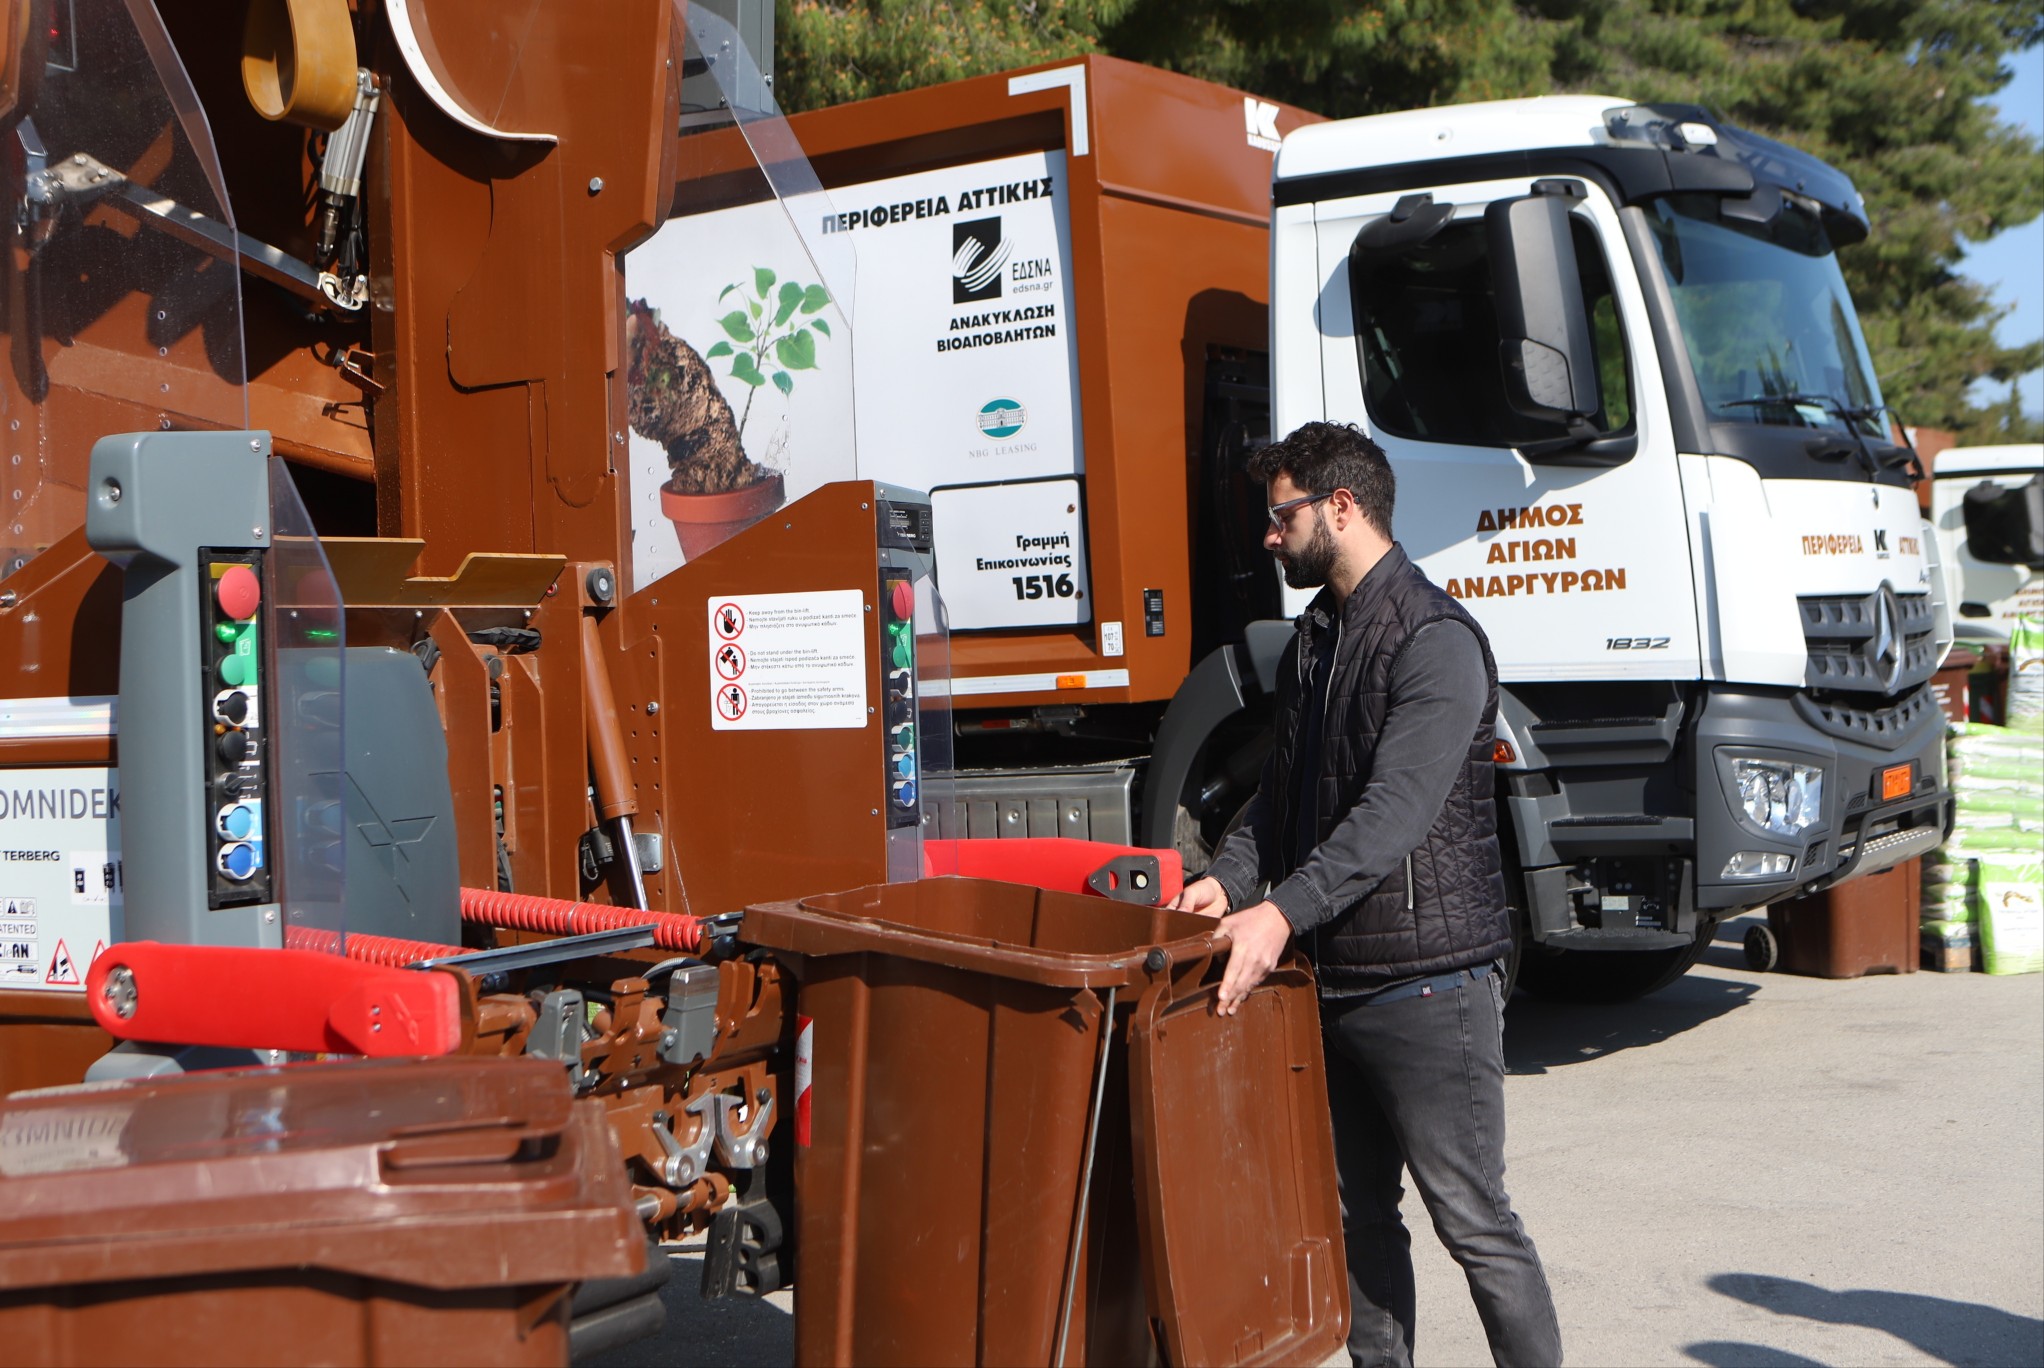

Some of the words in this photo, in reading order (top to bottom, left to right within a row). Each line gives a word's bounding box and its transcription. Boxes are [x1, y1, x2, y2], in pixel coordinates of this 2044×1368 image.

[822, 196, 950, 235] ΠΕΡΙΦΕΡΕΙΑ
[957, 176, 1054, 213] ΑΤΤΙΚΗΣ
[1012, 257, 1052, 281] ΕΔΣΝΑ
[1012, 280, 1053, 294] edsna.gr
[949, 304, 1055, 331] ΑΝΑΚΥΚΛΩΣΗ
[937, 324, 1056, 353] ΒΙΟΑΠΟΒΛΗΤΩΝ
[968, 449, 989, 459] NBG
[995, 443, 1037, 456] LEASING
[1476, 503, 1584, 532] ΔΗΜΟΣ
[1016, 531, 1070, 549] Γραμμή
[1486, 537, 1577, 564] ΑΓΙΩΝ
[1802, 533, 1864, 556] ΠΕΡΙΦΕΡΕΙΑ
[976, 553, 1072, 571] Επικοινωνίας
[1013, 573, 1074, 600] 1516
[1445, 567, 1627, 599] ΑΝΑΡΓΥΡΩΝ
[1606, 636, 1671, 650] 1832
[3, 850, 61, 862] TERBERG
[0, 923, 36, 934] ATENTED
